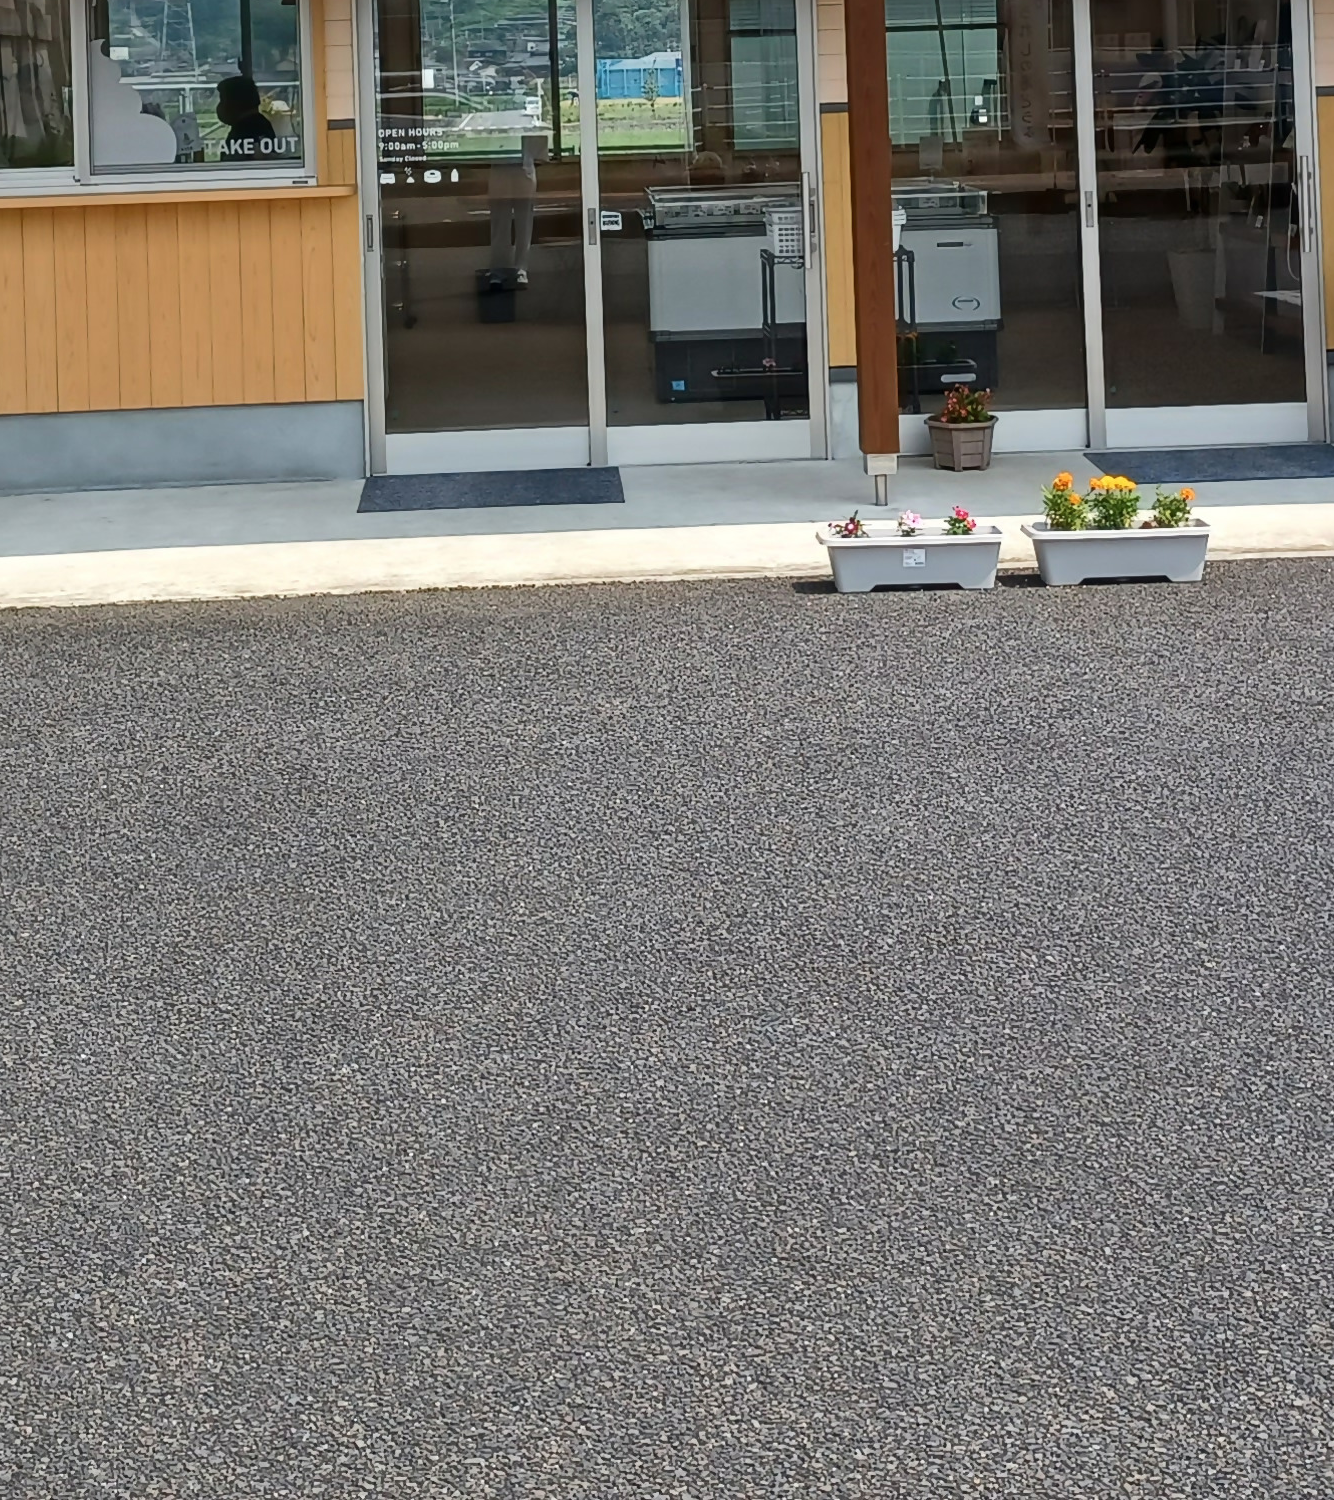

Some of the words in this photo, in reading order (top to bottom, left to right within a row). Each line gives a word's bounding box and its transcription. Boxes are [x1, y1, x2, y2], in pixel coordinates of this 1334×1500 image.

[378, 128, 405, 138] OPEN
[408, 127, 443, 137] HOURS
[204, 138, 255, 155] TAKE
[260, 137, 299, 154] OUT
